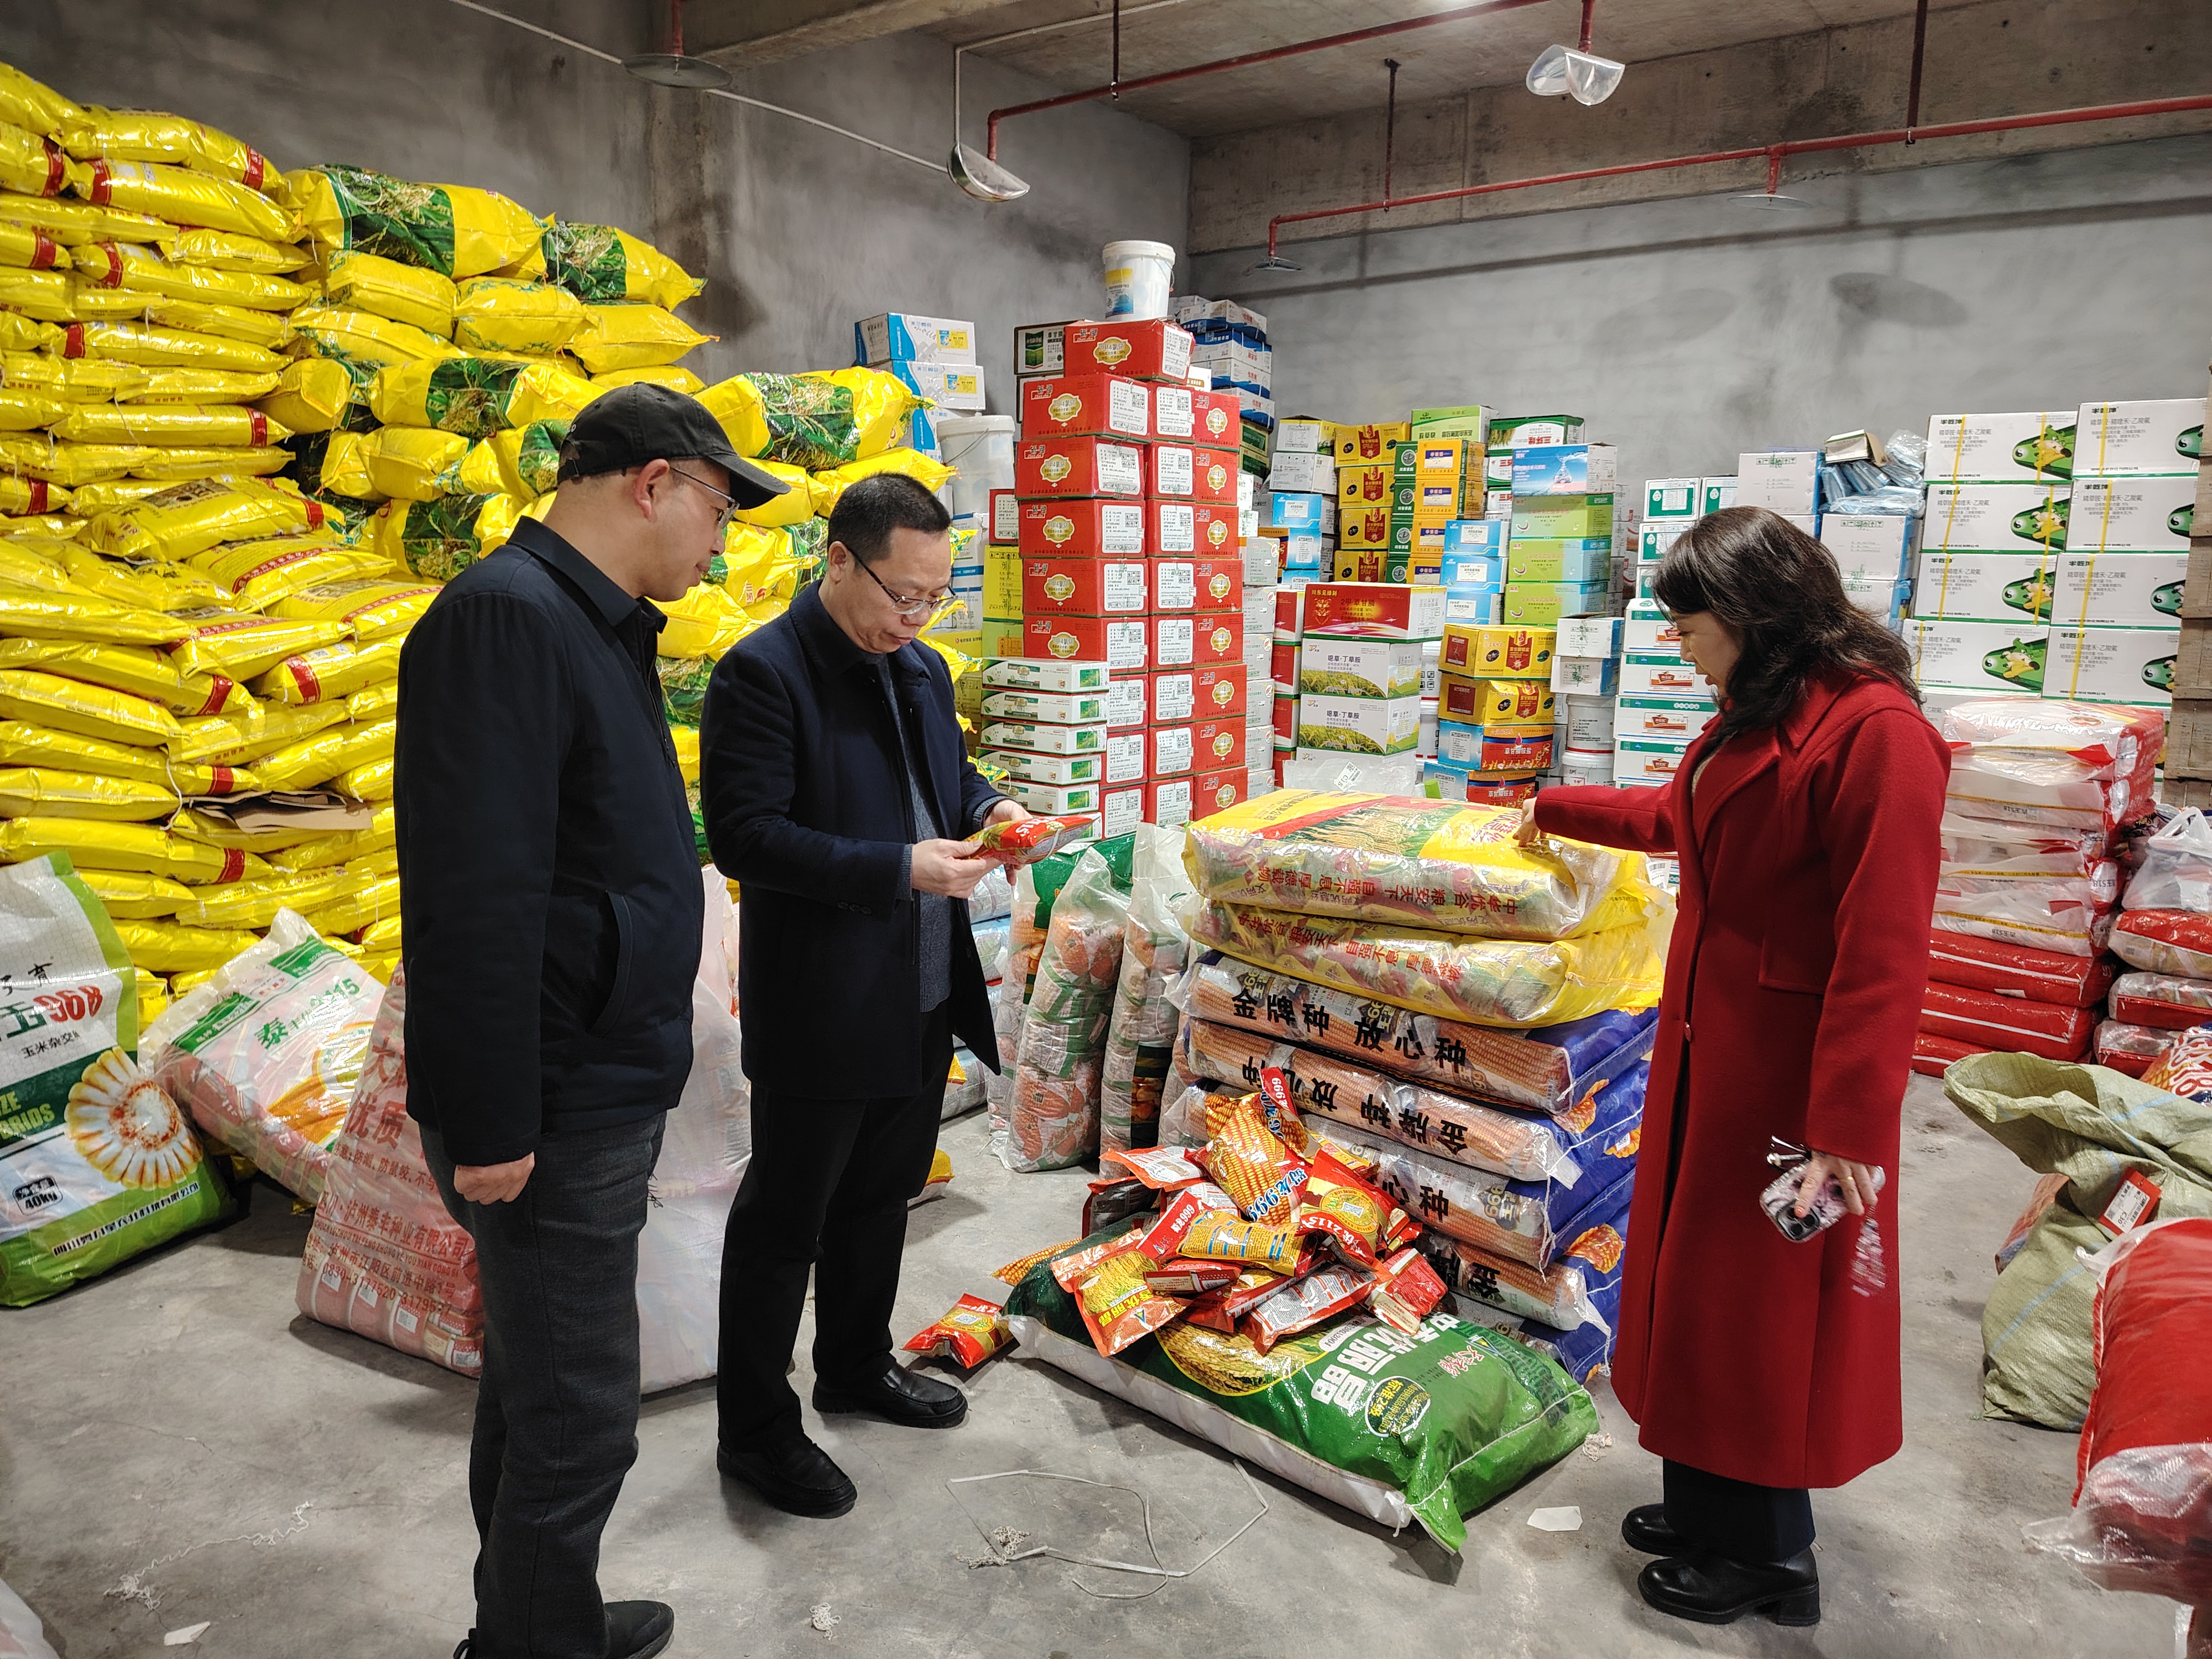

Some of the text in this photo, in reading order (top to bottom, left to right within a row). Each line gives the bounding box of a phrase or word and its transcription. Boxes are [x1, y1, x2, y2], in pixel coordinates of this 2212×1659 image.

[1258, 867, 1520, 916] 中华优谷 粮安天下 自强不息 厚德载物
[1238, 912, 1286, 937] 中华优谷
[1289, 925, 1339, 951] 粮安天下
[1345, 940, 1401, 964] 自强不息
[1232, 988, 1466, 1073] 金牌种 放心种
[345, 1089, 408, 1150] 优质
[1360, 1094, 1470, 1155] 金牌种
